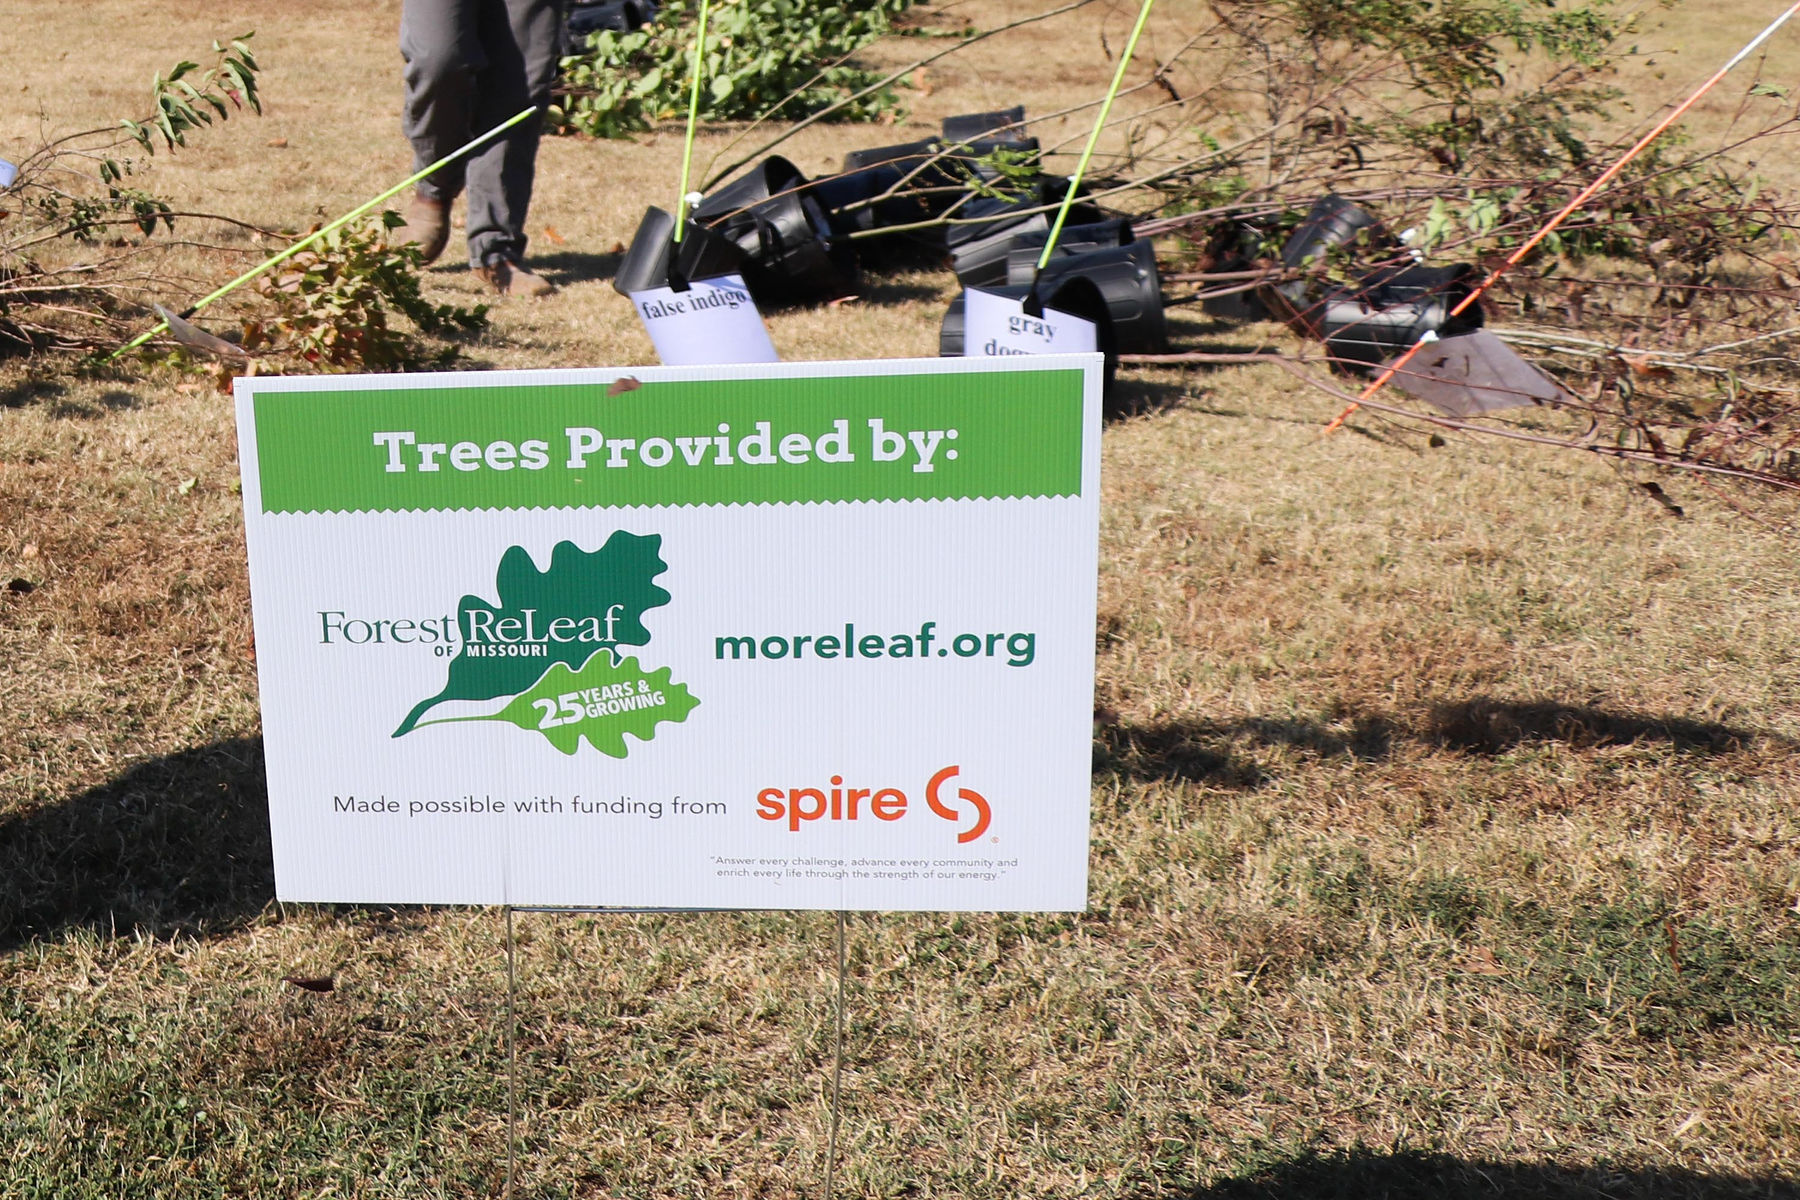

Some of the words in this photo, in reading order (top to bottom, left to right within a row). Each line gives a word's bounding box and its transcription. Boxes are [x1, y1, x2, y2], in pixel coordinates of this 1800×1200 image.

[642, 298, 686, 320] false
[687, 287, 748, 311] indigo
[1008, 314, 1057, 343] gray
[373, 431, 549, 473] Trees
[565, 419, 855, 469] Provided
[868, 418, 959, 473] by:
[316, 610, 456, 644] Forest
[464, 604, 625, 644] ReLeaf
[433, 645, 454, 658] OF
[466, 644, 549, 658] MISSOURI
[715, 621, 1036, 668] moreleaf.org
[531, 693, 588, 730] 25
[579, 681, 635, 705] YEARS
[637, 679, 651, 694] &
[584, 691, 667, 719] GROWING
[333, 794, 401, 814] Made
[409, 794, 506, 818] possible
[513, 795, 563, 814] with
[571, 795, 663, 819] funding
[671, 796, 727, 814] from
[756, 775, 908, 832] spire
[716, 868, 750, 878] enrich
[752, 869, 783, 879] every
[785, 868, 803, 878] life
[805, 868, 849, 880] through
[852, 869, 871, 879] the
[873, 870, 920, 881] strength
[922, 869, 935, 879] of
[937, 871, 956, 880] our
[759, 858, 789, 868] every
[791, 857, 848, 868] challenge,
[851, 858, 897, 867] advance
[900, 860, 930, 869] every
[932, 858, 994, 869] community
[996, 858, 1019, 867] and
